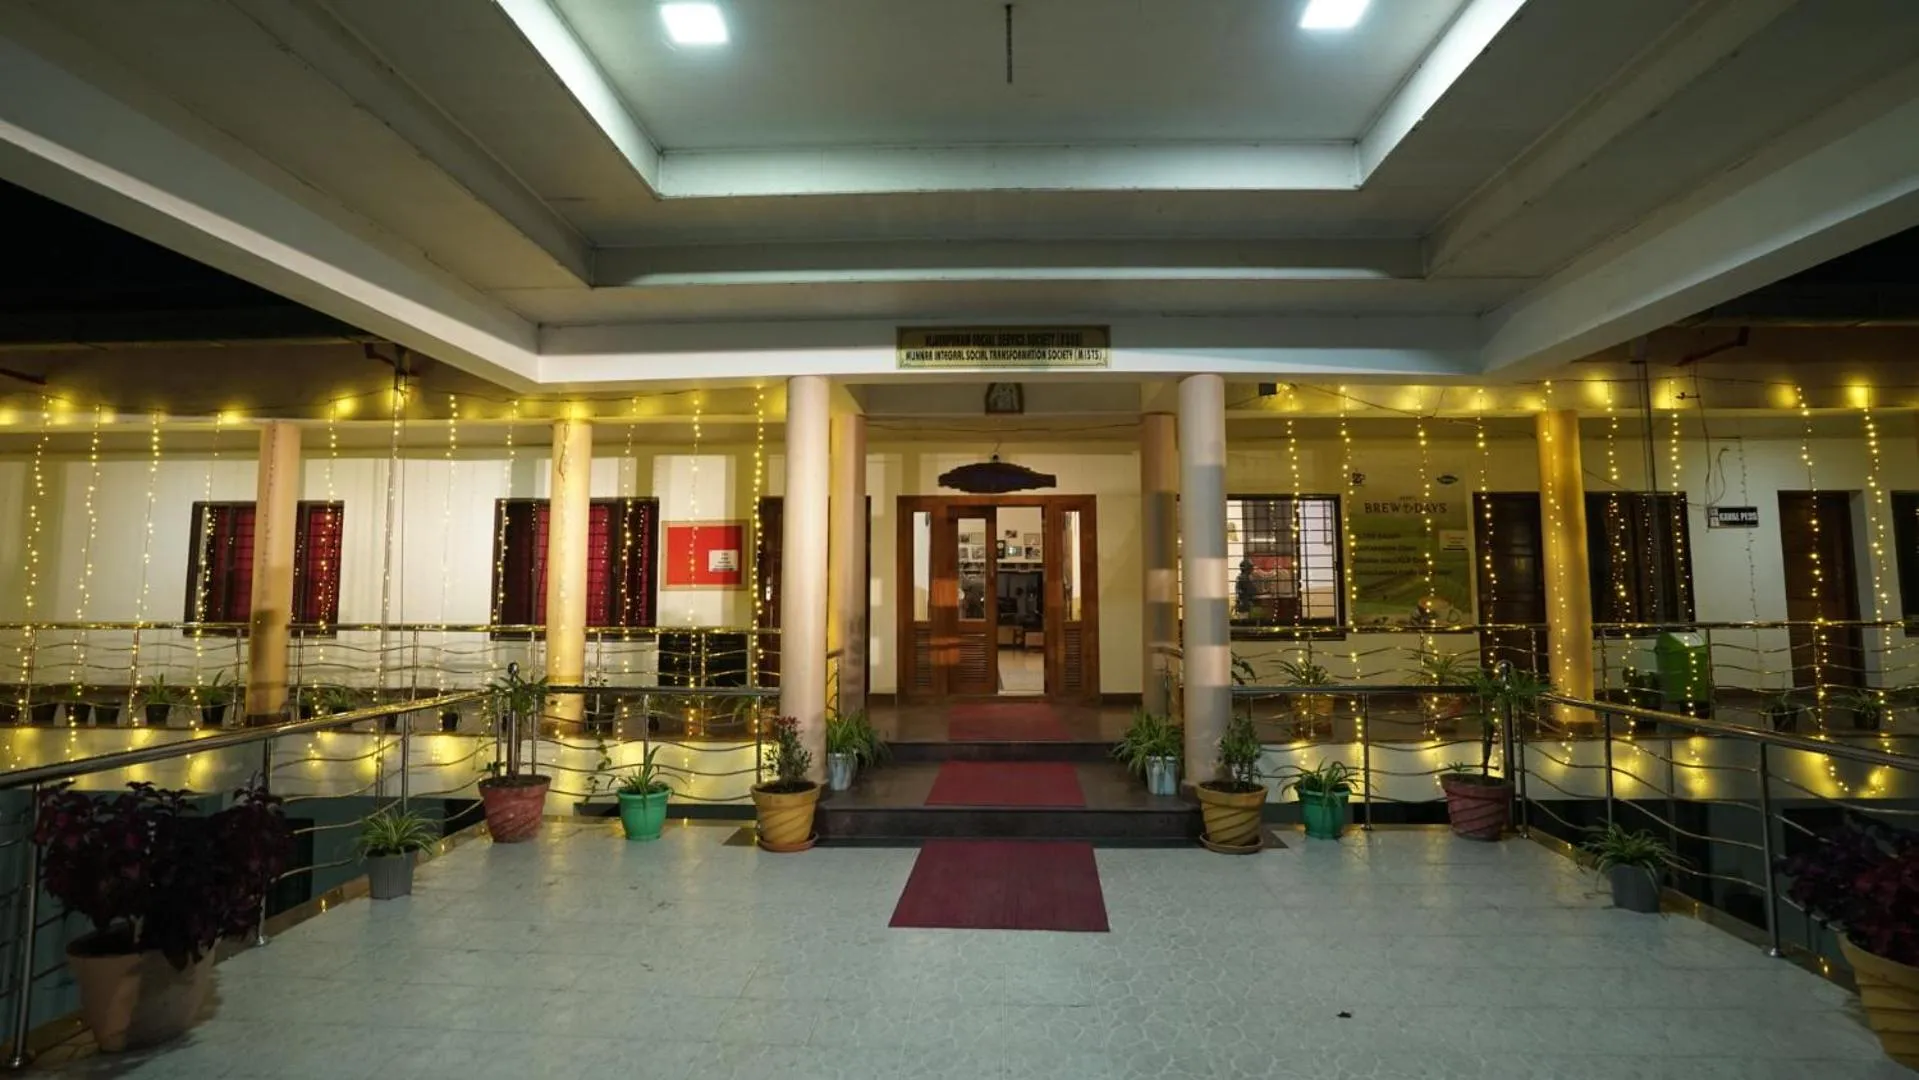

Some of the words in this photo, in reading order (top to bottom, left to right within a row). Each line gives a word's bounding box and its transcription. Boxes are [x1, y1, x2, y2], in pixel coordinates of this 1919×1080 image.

[935, 350, 964, 360] INTEGRAL
[965, 350, 988, 360] SOCIAL
[989, 350, 1046, 360] TRANSFORMATION
[1047, 349, 1072, 360] SOCIETY
[1364, 502, 1400, 514] BREW
[1414, 502, 1447, 514] DAYS
